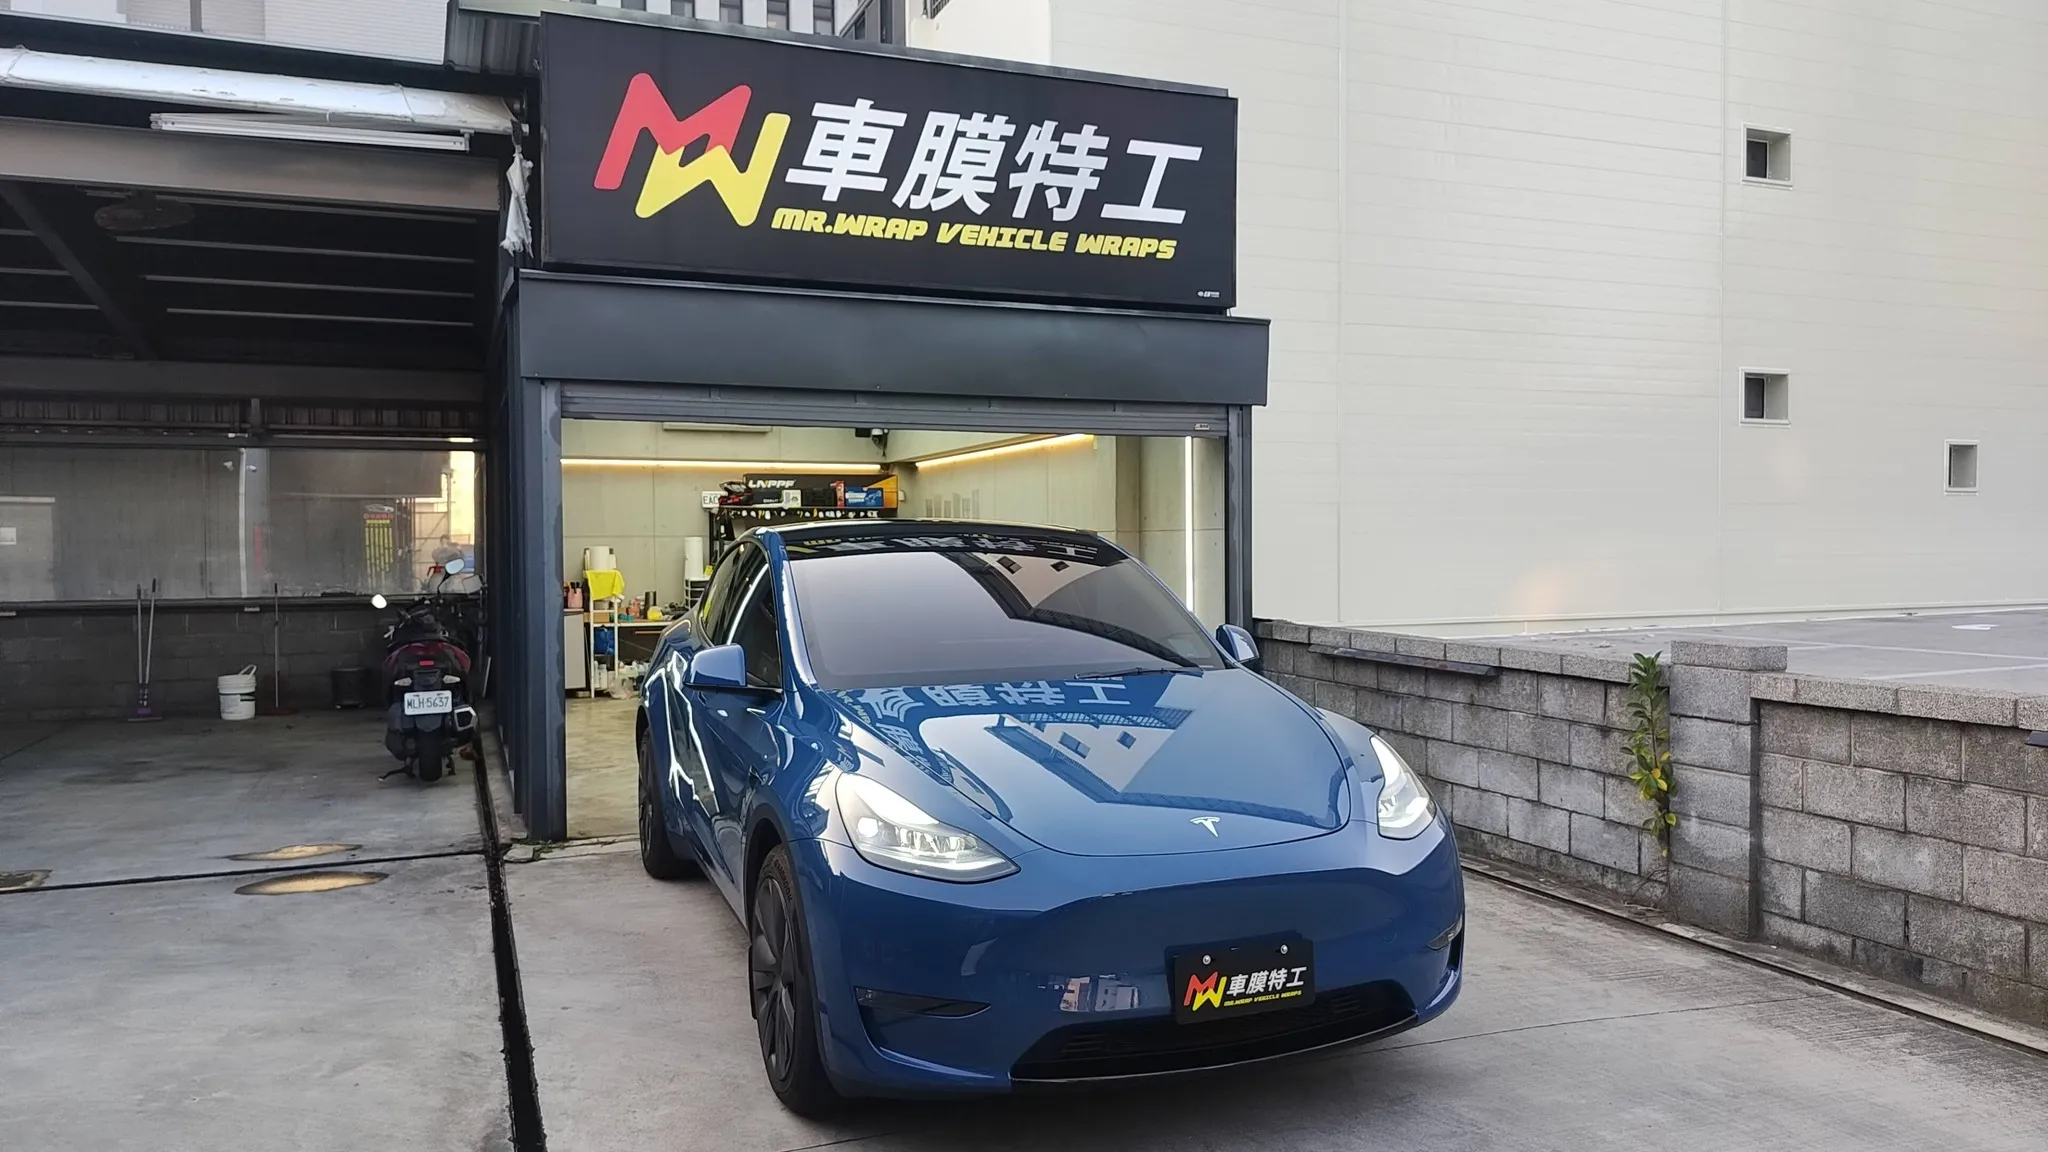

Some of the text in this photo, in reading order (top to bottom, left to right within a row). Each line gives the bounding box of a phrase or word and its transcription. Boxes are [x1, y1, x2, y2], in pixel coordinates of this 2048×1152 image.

[785, 98, 1202, 222] 車膜特工
[771, 207, 1177, 259] MR.WRAP VEHICLE WRAPS
[1226, 966, 1307, 997] 車膜特工
